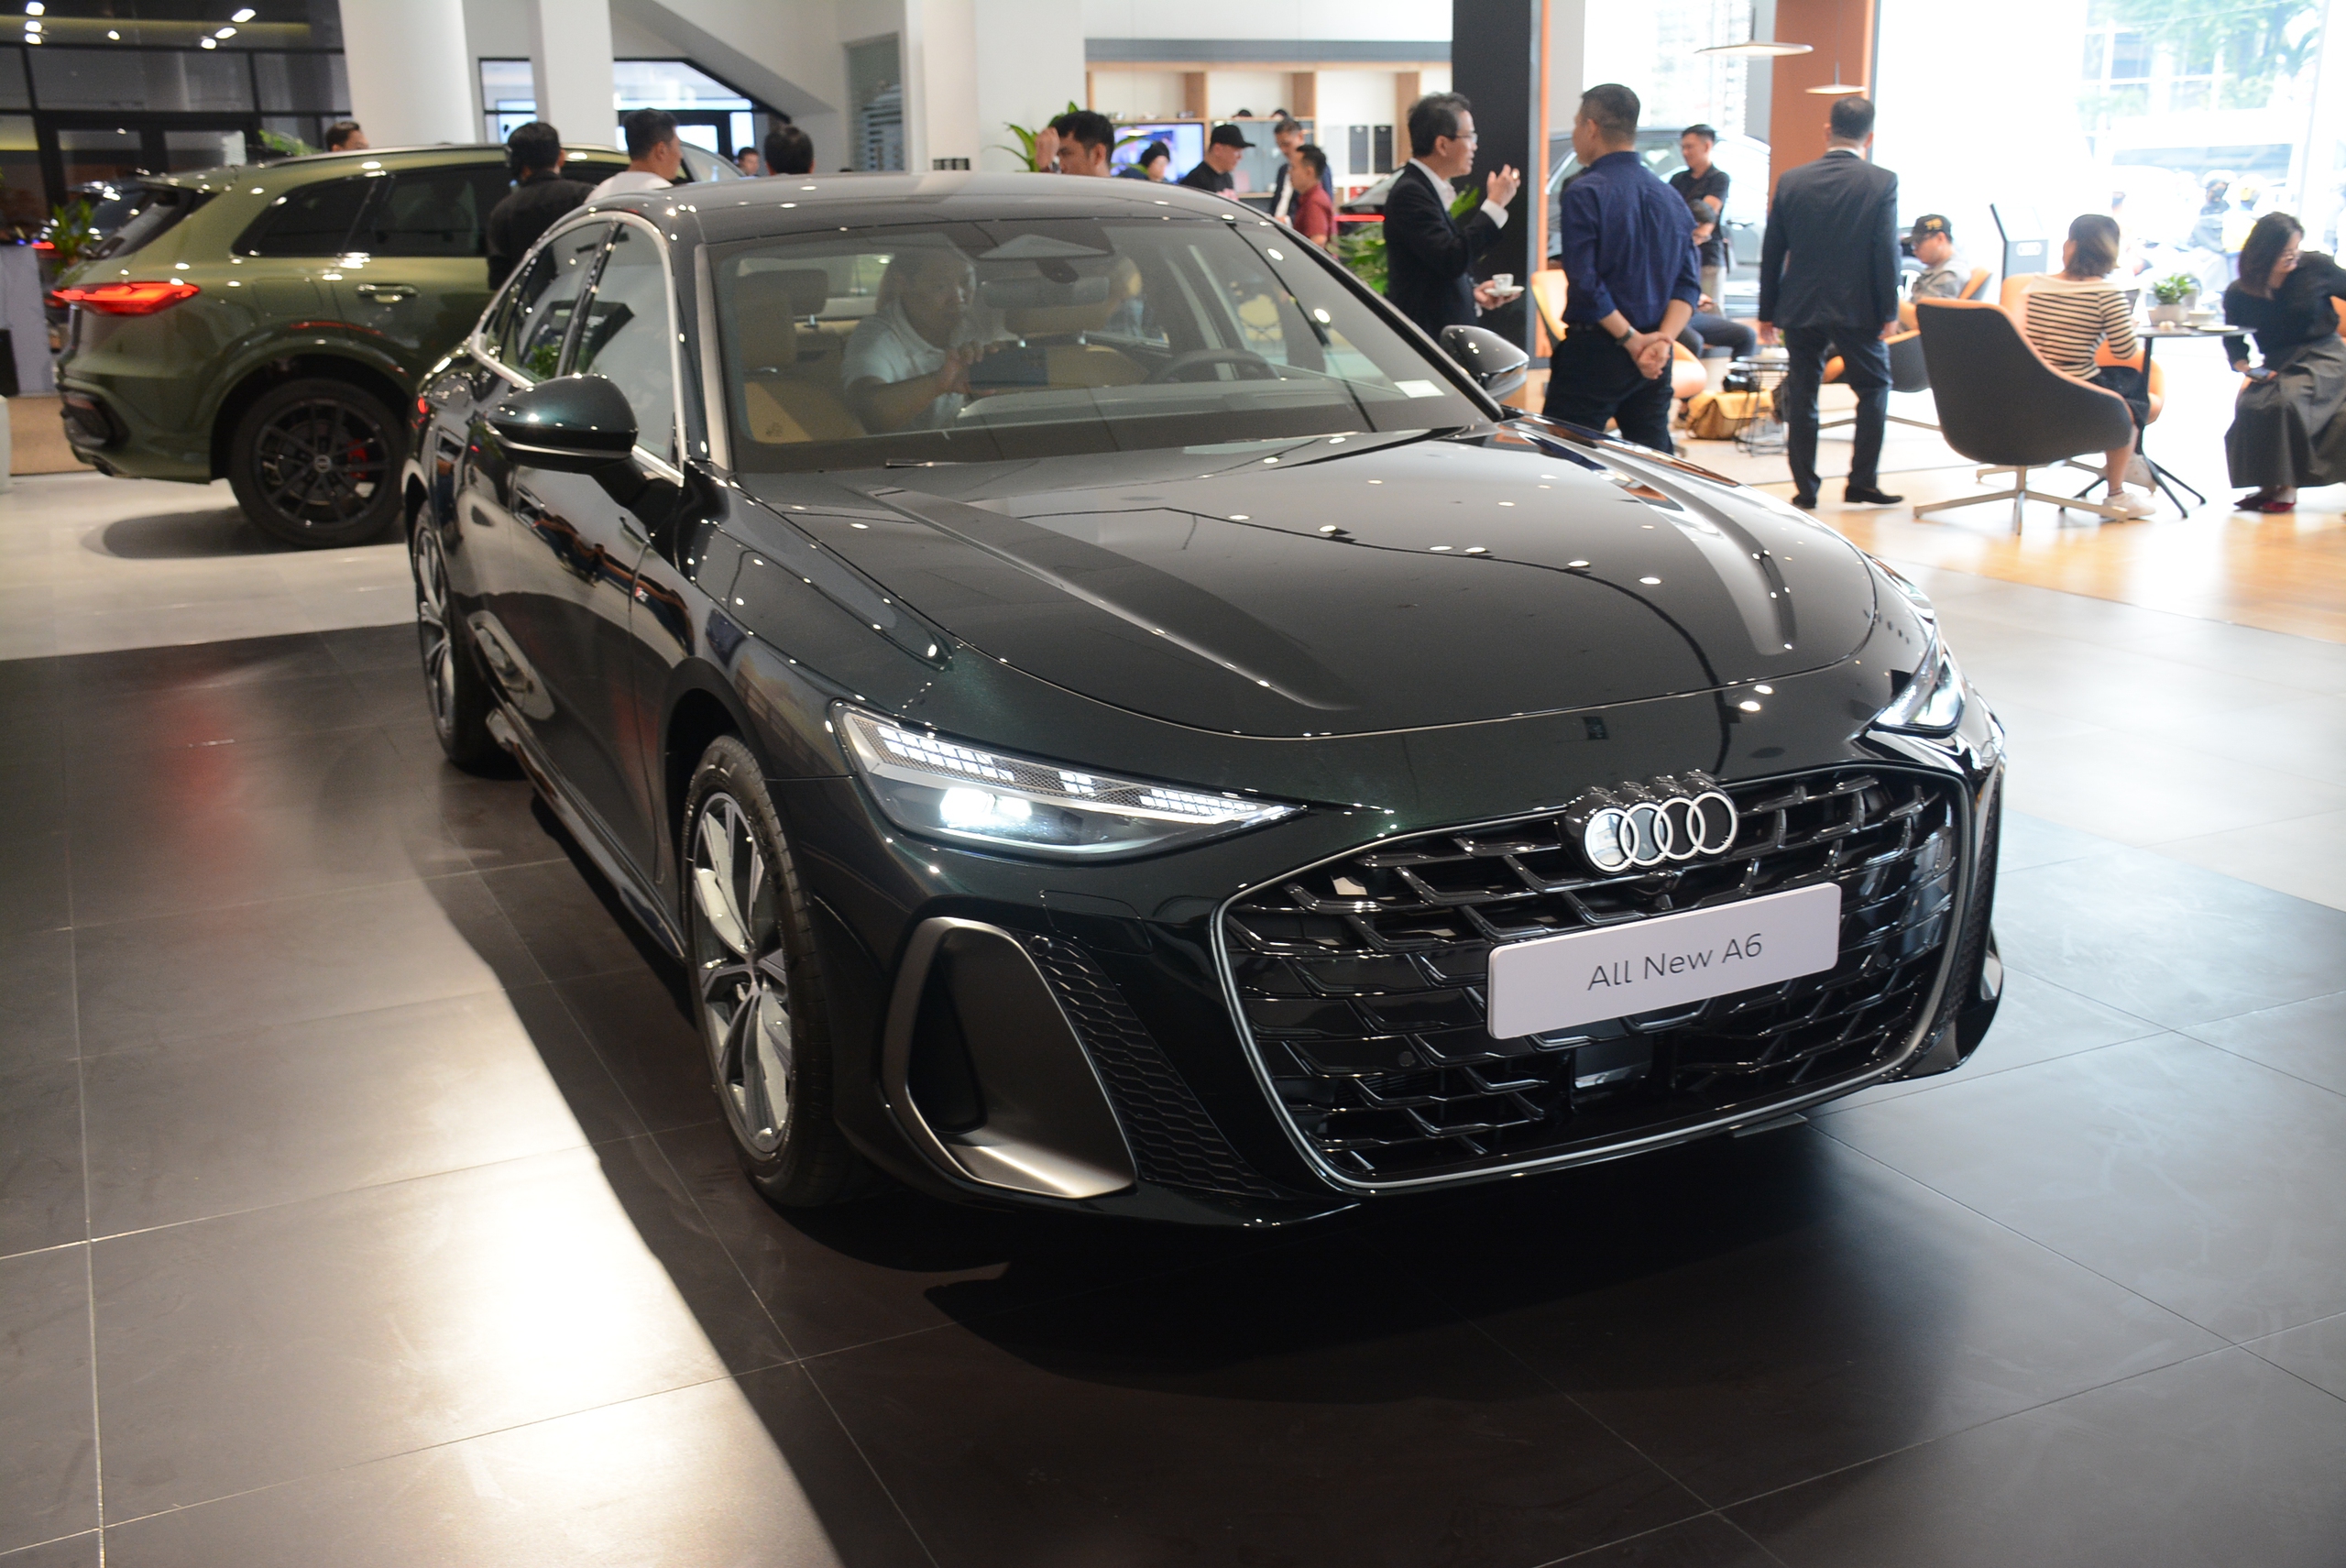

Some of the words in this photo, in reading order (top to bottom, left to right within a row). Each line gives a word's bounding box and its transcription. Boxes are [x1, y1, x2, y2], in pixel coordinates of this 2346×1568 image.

[1587, 959, 1632, 991] All
[1644, 949, 1713, 980] New
[1722, 933, 1762, 963] A6
